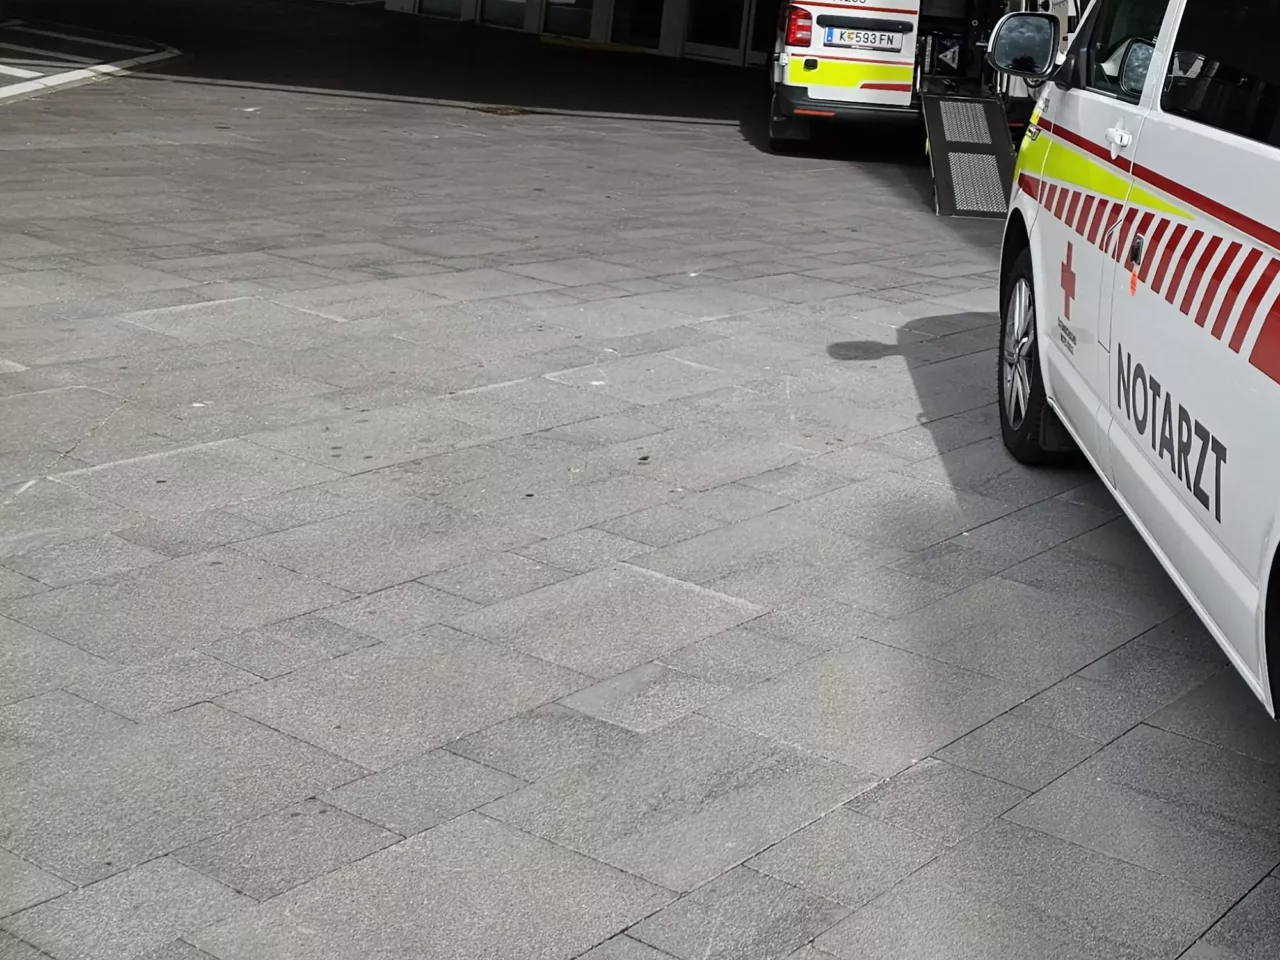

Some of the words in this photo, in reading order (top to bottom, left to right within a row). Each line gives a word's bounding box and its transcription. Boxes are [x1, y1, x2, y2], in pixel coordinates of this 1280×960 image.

[839, 31, 847, 42] K
[855, 32, 877, 44] 593
[879, 34, 894, 46] FN
[1117, 342, 1228, 524] NOTARZT
